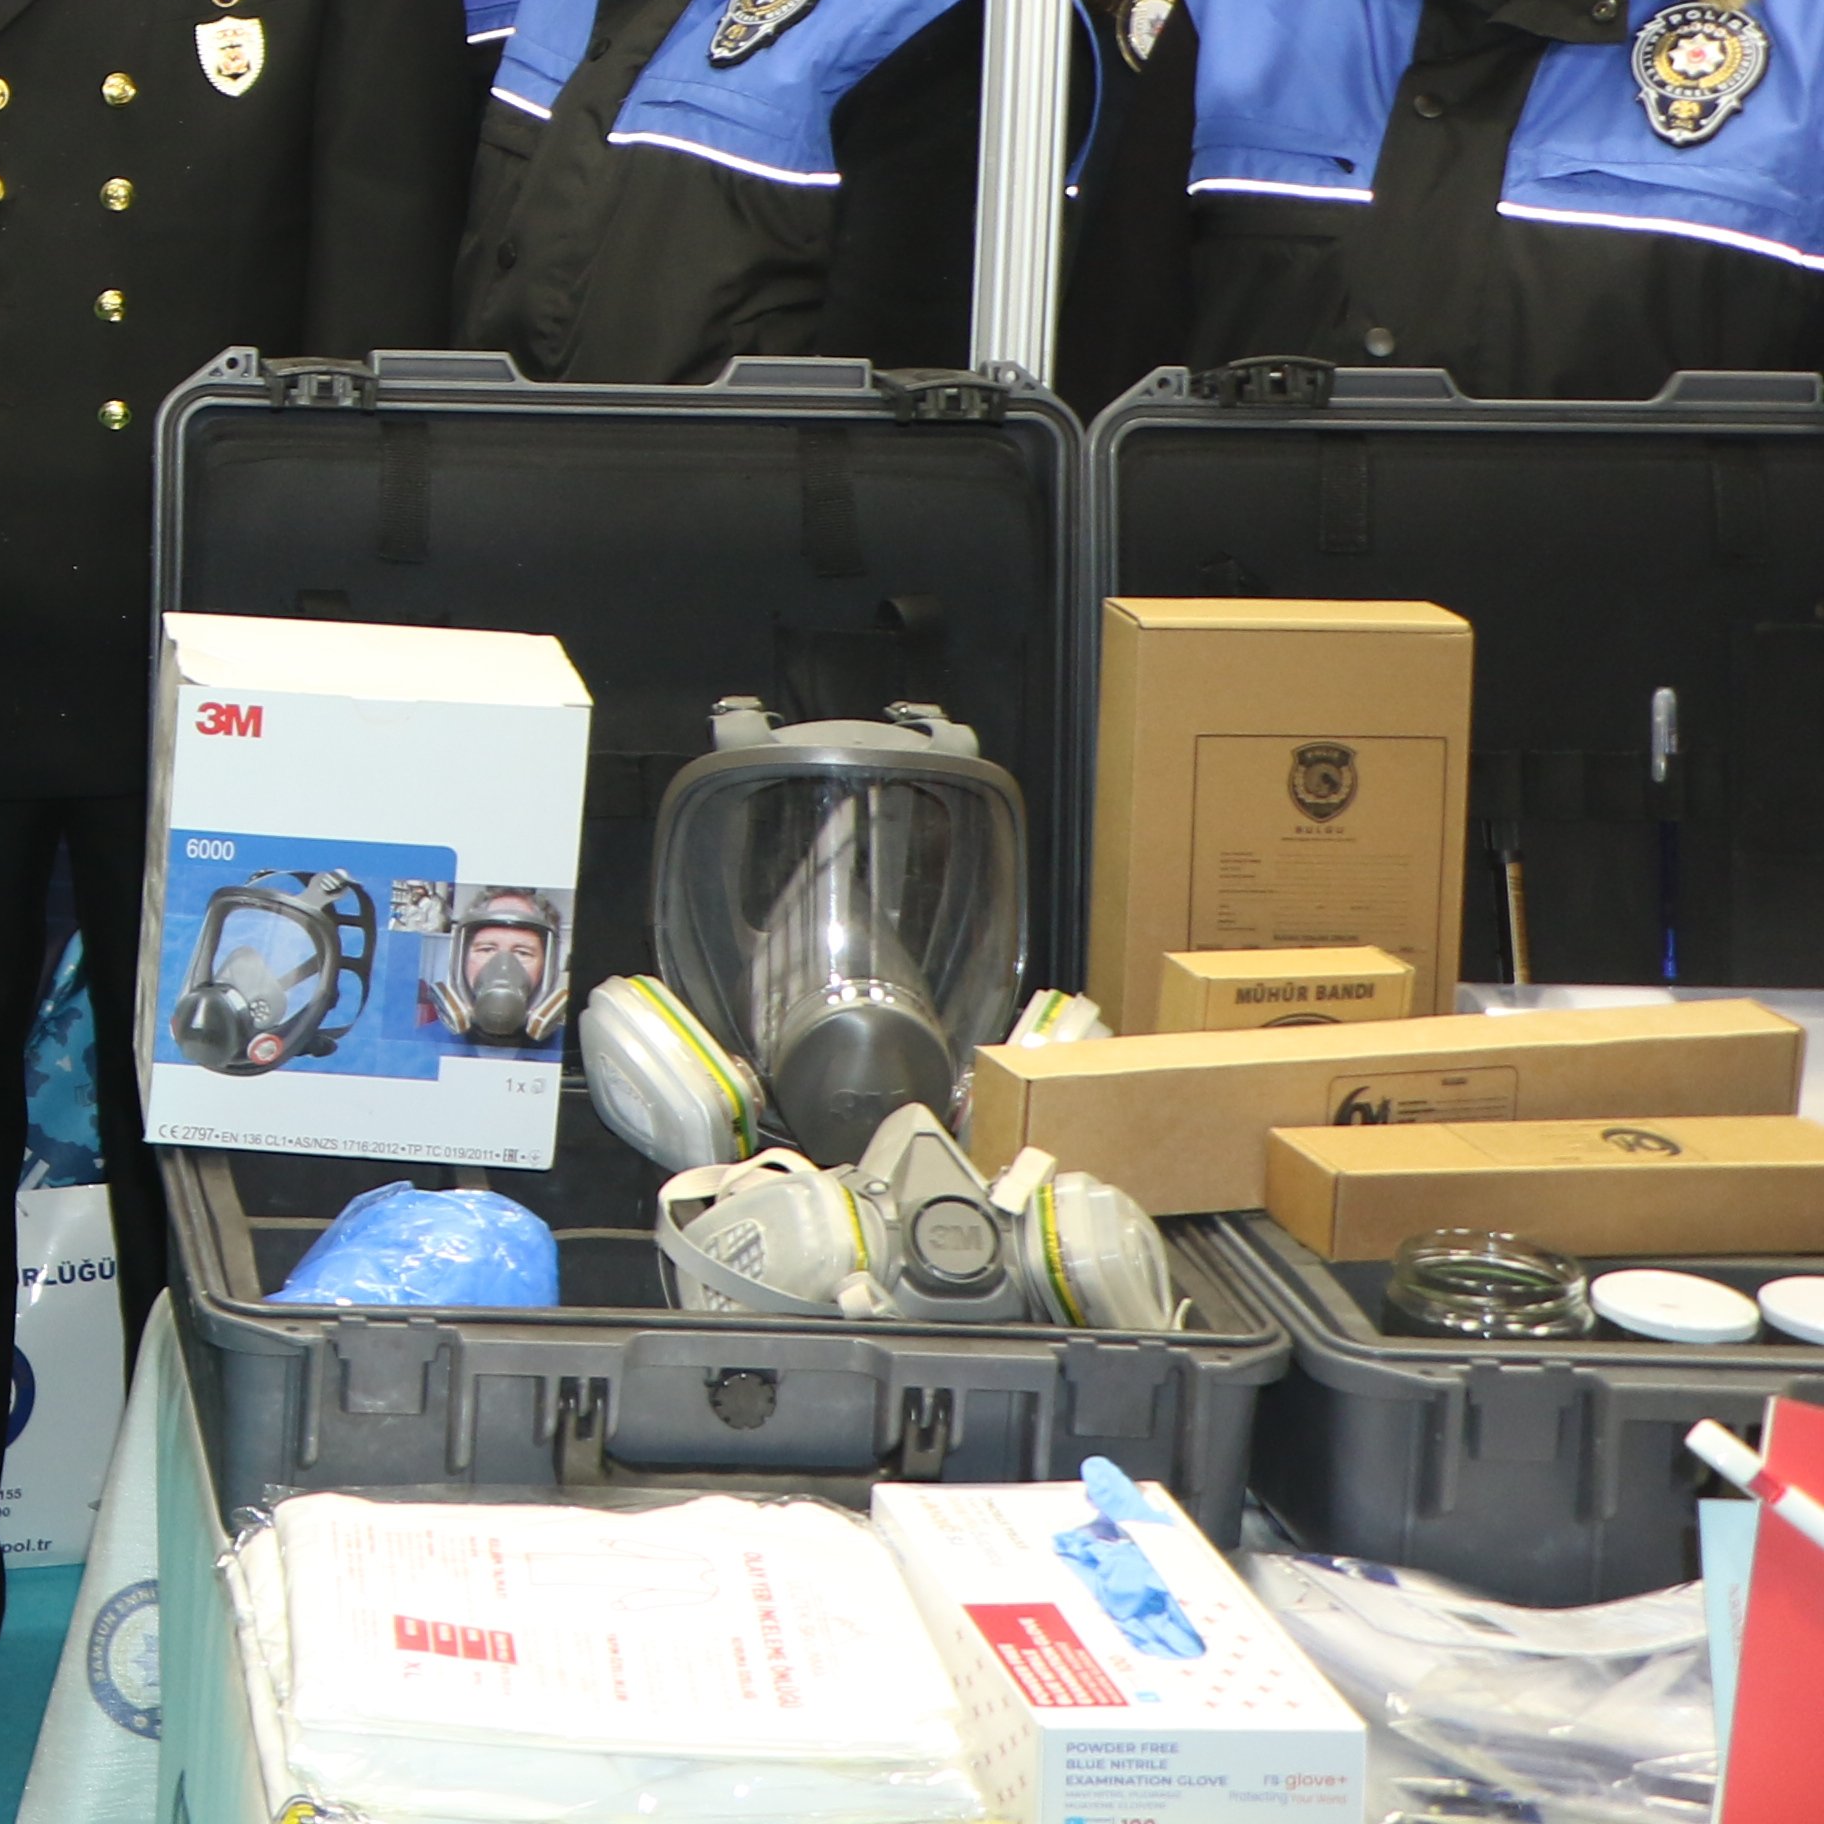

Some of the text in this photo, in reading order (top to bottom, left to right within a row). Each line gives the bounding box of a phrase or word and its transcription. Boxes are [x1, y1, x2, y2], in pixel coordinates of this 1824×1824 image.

[195, 701, 263, 738] 3M
[186, 837, 235, 862] 6000
[1235, 982, 1376, 1005] MÜHÜR BANDI
[182, 1125, 214, 1142] 2797
[221, 1131, 238, 1143] EN
[929, 1224, 984, 1251] 3M
[1065, 1742, 1180, 1754] POWDER FREE
[1065, 1758, 1169, 1770] BLUE NITRILE
[1065, 1774, 1228, 1787] EXAMINATION GLOVE
[1285, 1773, 1348, 1791] glove+
